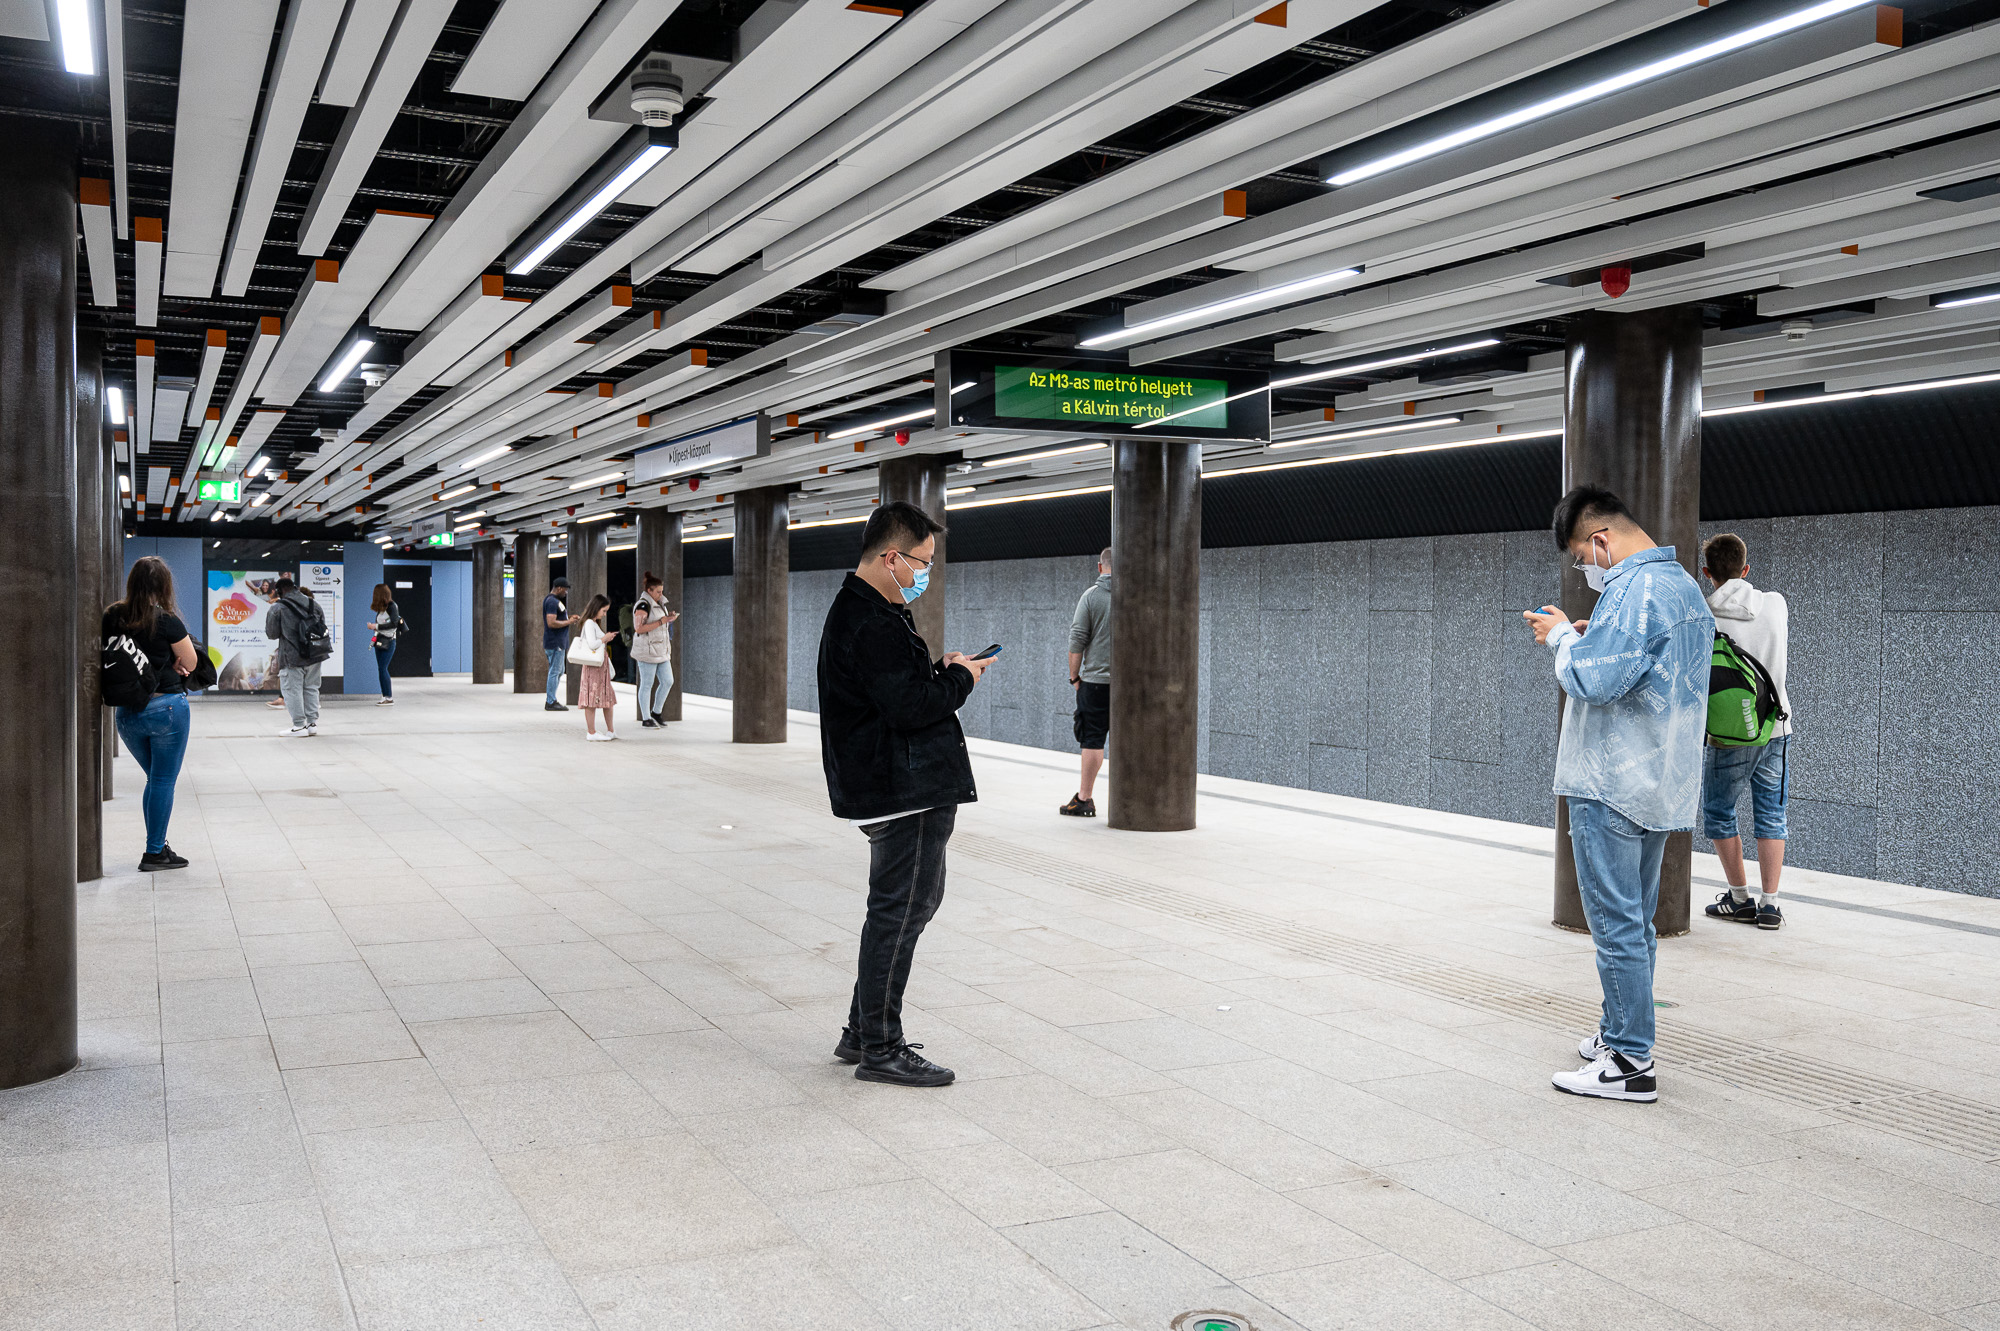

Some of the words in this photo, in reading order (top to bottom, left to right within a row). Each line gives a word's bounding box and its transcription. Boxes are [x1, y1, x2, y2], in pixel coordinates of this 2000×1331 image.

[1029, 372, 1047, 388] Az
[1049, 373, 1091, 390] M3-as
[1093, 376, 1138, 393] metró
[1140, 379, 1194, 399] helyett
[1062, 401, 1071, 414] a
[1074, 399, 1120, 417] Kálvin
[672, 441, 711, 466] Újpest-központ
[1597, 654, 1620, 666] STREET
[1620, 649, 1643, 661] TREND
